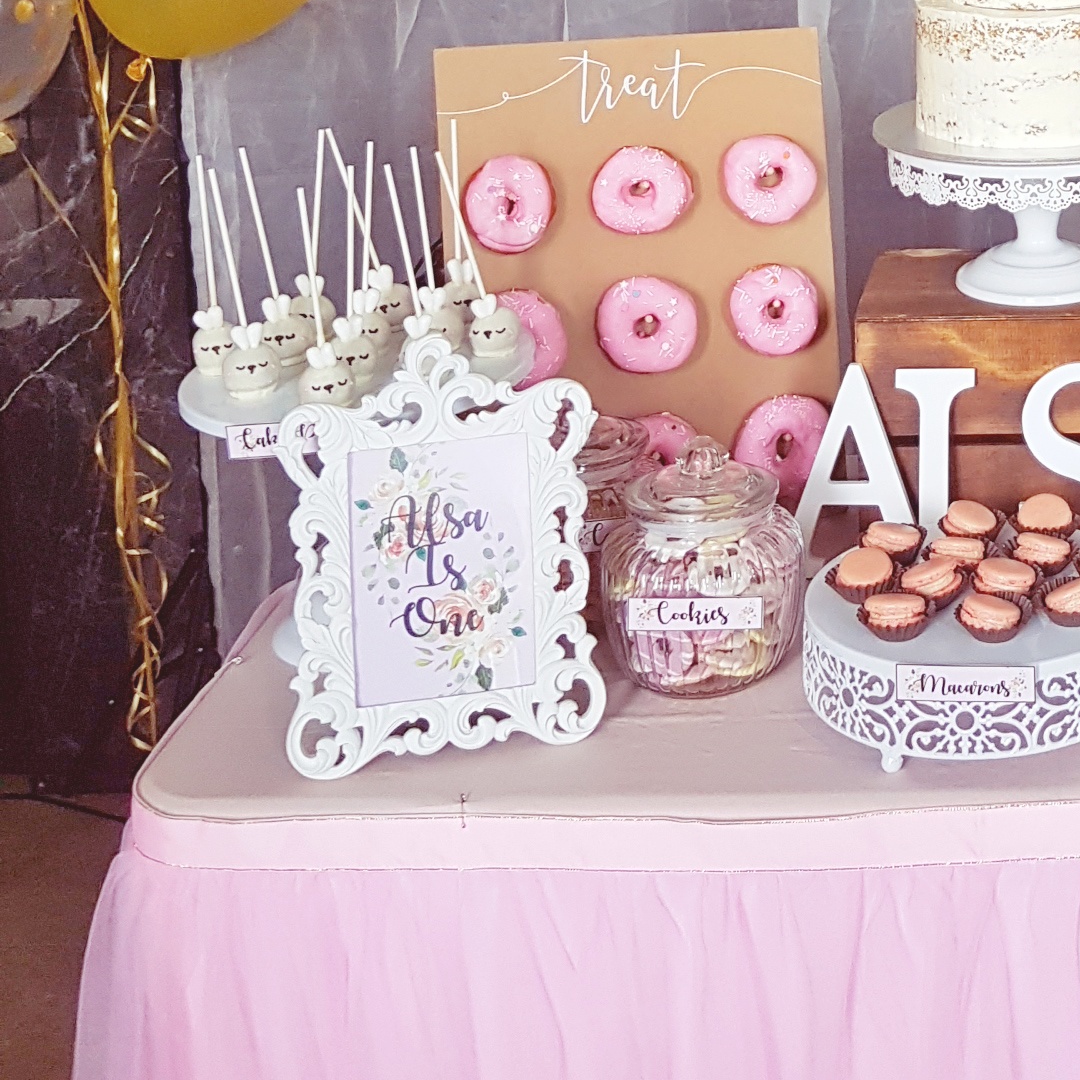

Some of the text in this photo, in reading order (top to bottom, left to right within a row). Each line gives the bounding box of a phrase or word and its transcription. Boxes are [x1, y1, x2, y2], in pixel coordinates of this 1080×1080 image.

[558, 48, 706, 124] treat
[235, 427, 286, 452] Cak
[405, 543, 467, 593] Is
[389, 596, 484, 637] One
[649, 600, 730, 626] Cookies
[914, 673, 1010, 697] Macarons
